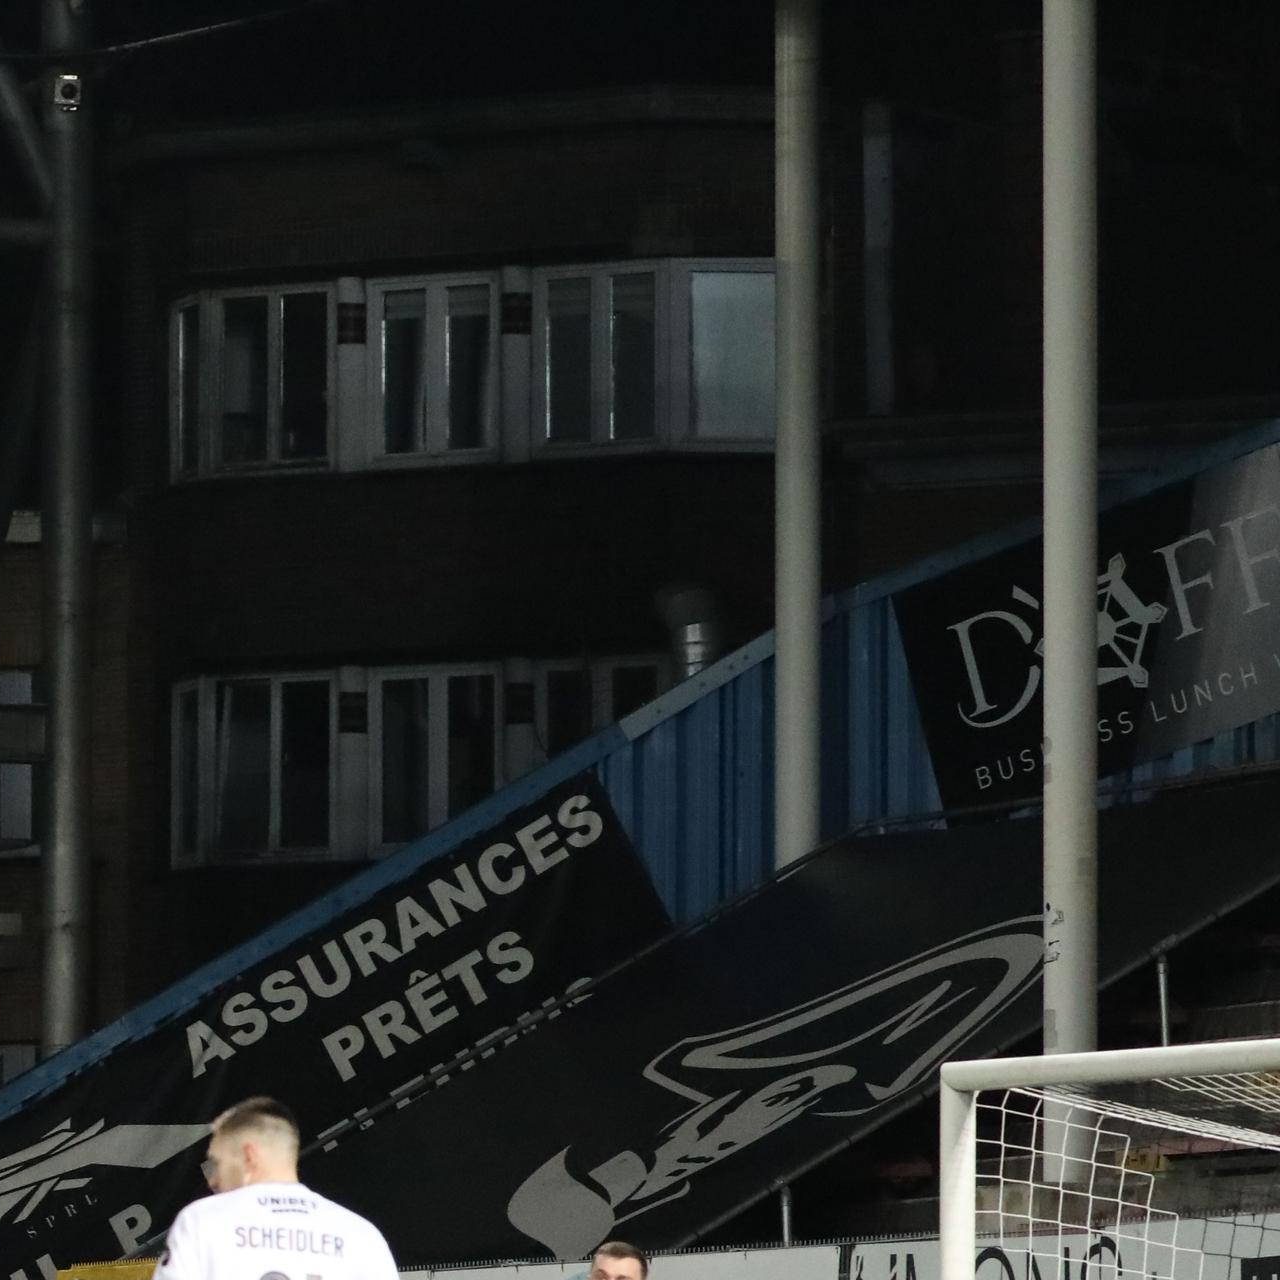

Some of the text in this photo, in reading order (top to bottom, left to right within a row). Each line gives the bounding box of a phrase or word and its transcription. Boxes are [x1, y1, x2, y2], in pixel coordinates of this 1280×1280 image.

[976, 665, 1258, 790] BUSSS LUNCH
[185, 794, 604, 1078] ASSURANCES
[322, 930, 535, 1083] PRÊTS
[235, 1226, 345, 1259] SCHEIDLER
